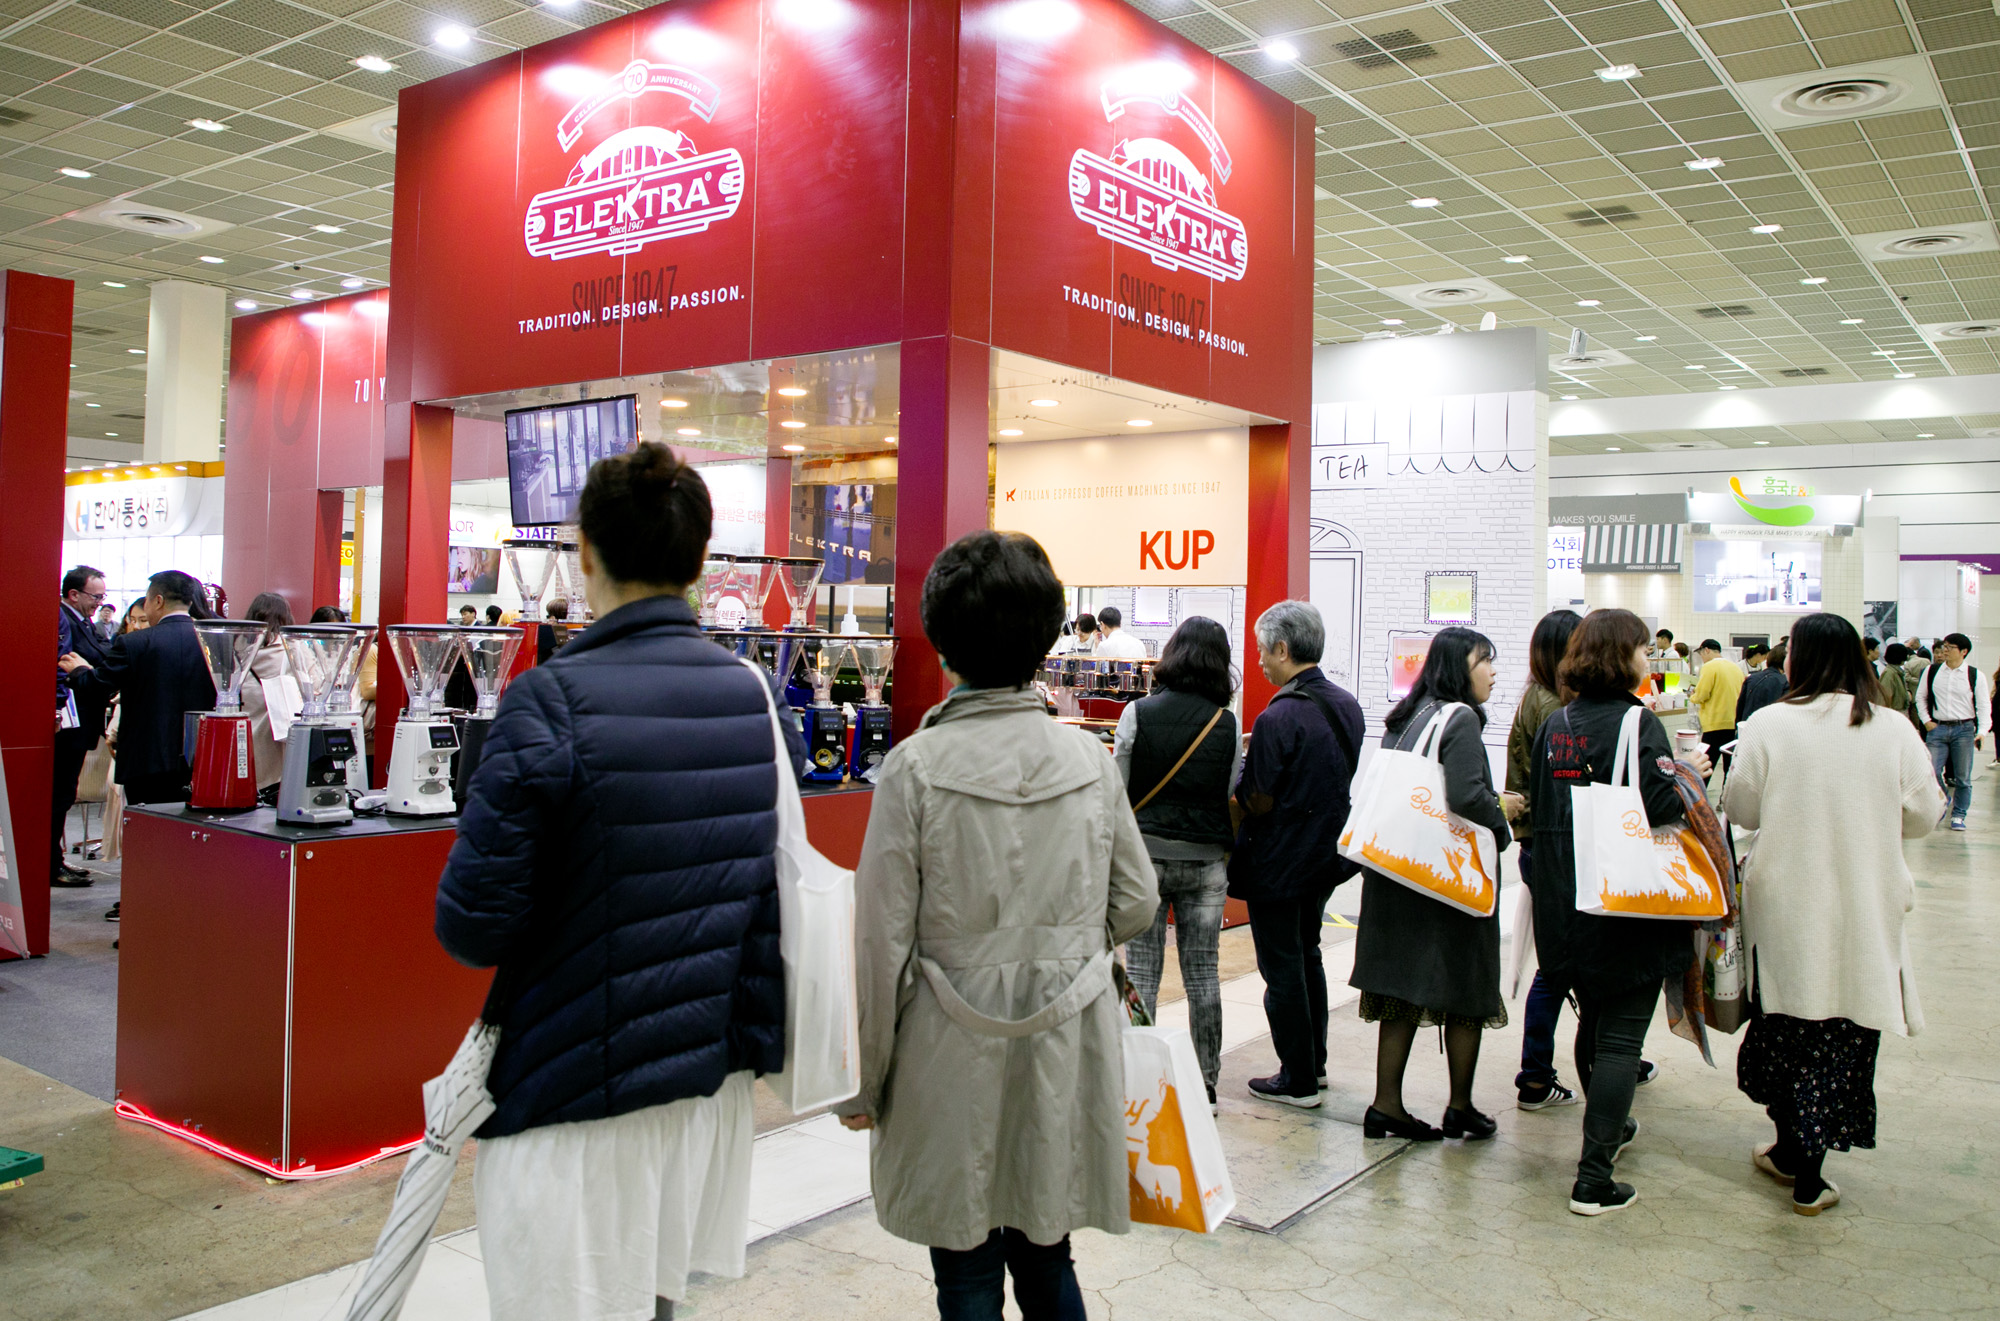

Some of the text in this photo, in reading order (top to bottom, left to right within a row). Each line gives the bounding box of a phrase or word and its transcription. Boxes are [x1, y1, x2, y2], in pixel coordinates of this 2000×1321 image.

[629, 73, 643, 88] 70
[650, 75, 702, 96] ANNIVERSARY
[1181, 105, 1220, 153] ANNIVERSARY
[553, 178, 711, 238] ELEKTRA
[1099, 180, 1227, 260] ELEKTRA
[608, 219, 645, 236] Since 1947
[1150, 231, 1180, 251] Since 1947
[518, 285, 745, 334] TRADITION. DESIGN. PASSION.
[572, 265, 678, 332] SINCE 1947
[1120, 273, 1205, 349] SINCE 1947
[1063, 285, 1249, 357] TRADITION. DESIGN. PASSION.
[355, 378, 370, 403] 70
[1319, 454, 1369, 480] TEA
[1020, 489, 1050, 501] ITALIAN
[1054, 487, 1092, 500] ESPRESSO
[1095, 485, 1124, 498] COFFEE
[1127, 483, 1169, 497] MACHINES
[1172, 482, 1197, 495] SINCE
[1201, 481, 1221, 494] 1947
[1552, 515, 1585, 524] MAKES
[1587, 515, 1606, 523] YOU
[1608, 514, 1636, 523] SMILE
[1140, 529, 1215, 571] KUP
[1553, 769, 1582, 778] VICTORY
